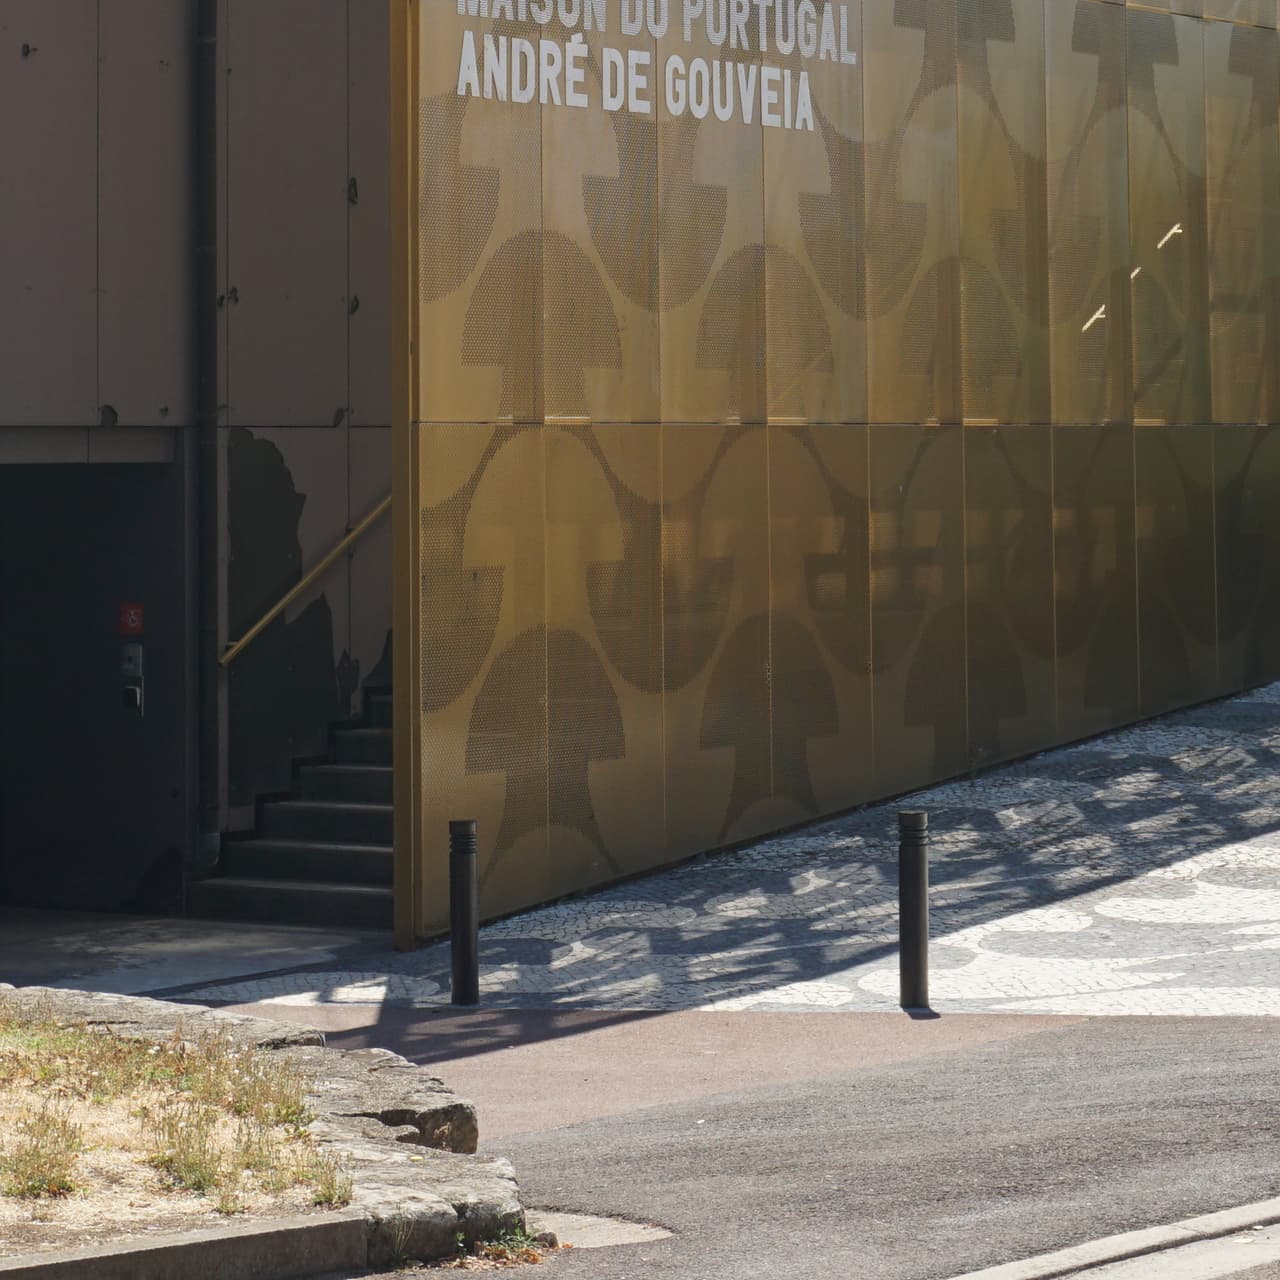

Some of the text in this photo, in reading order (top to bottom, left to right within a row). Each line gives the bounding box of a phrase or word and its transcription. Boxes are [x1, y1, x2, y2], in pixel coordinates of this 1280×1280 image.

[457, 30, 815, 131] ANDRÉ DE GOUVEIA
